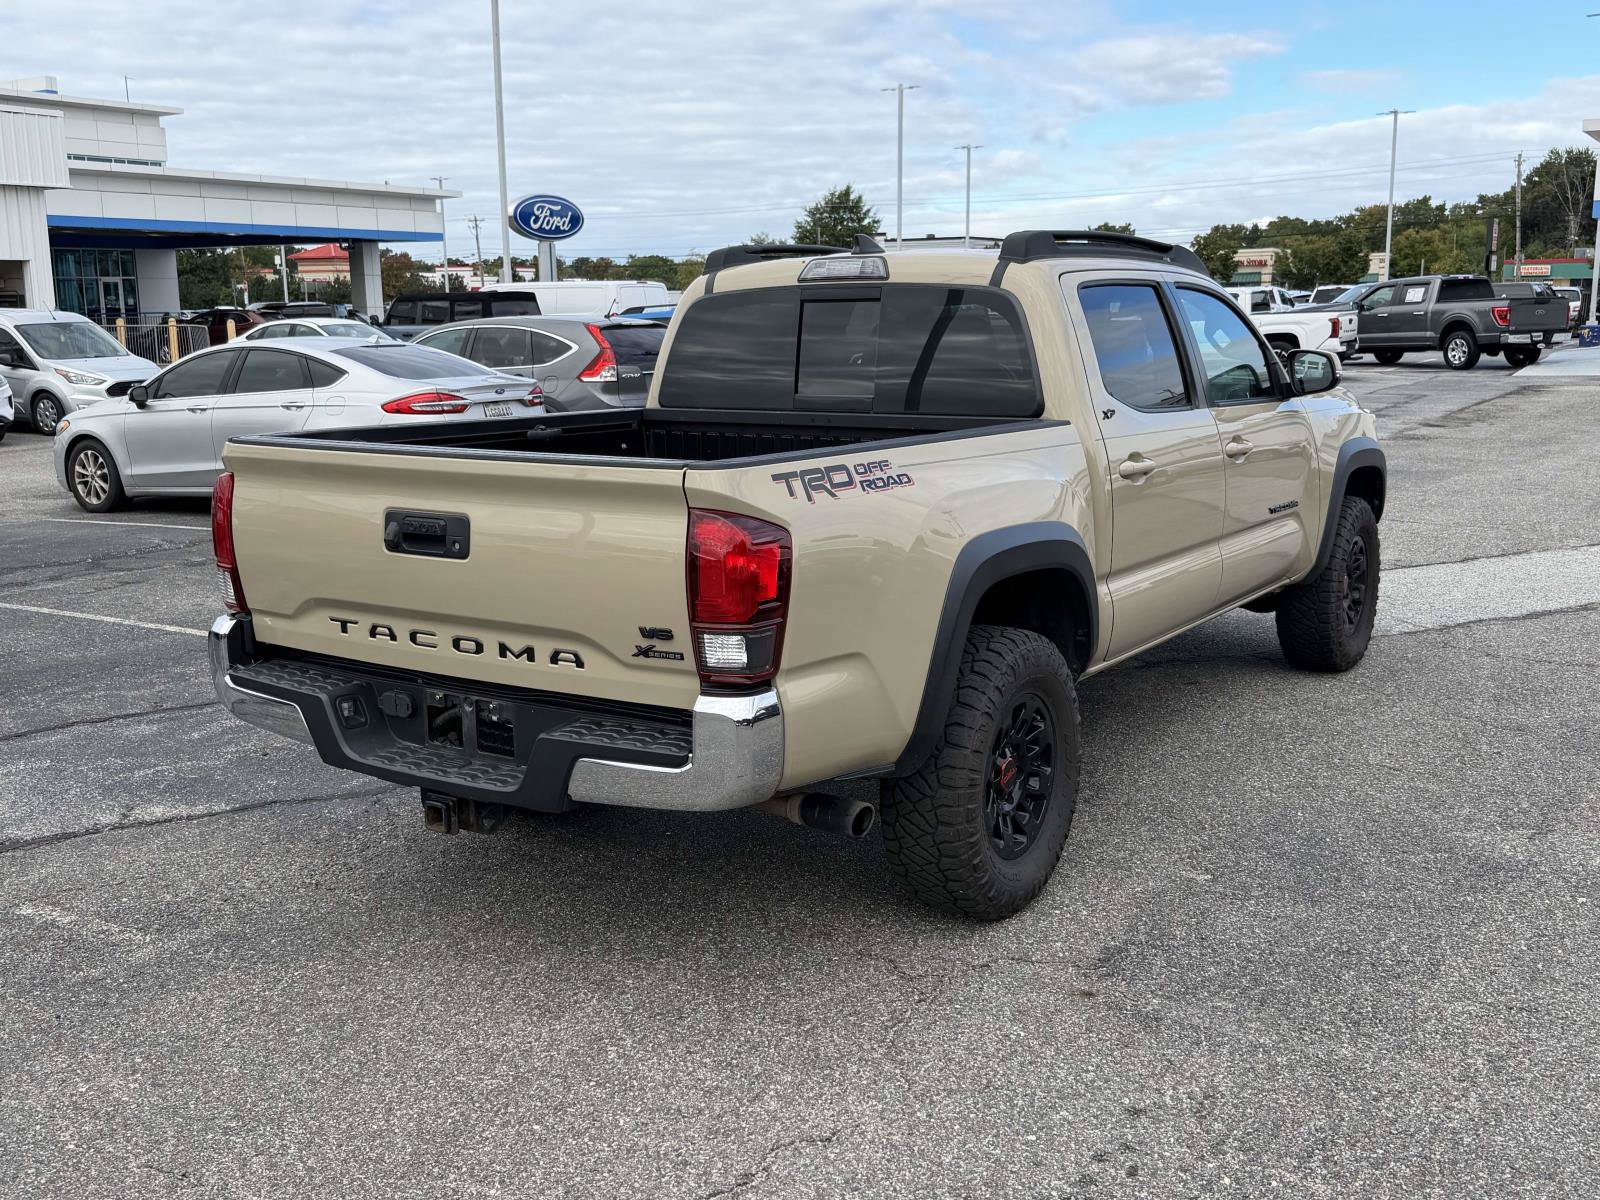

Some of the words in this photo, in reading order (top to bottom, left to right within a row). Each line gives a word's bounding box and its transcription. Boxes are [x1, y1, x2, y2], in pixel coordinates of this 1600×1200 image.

[530, 203, 572, 230] Ford
[853, 459, 893, 478] OFF
[770, 463, 857, 504] TRD
[858, 473, 915, 494] ROAD
[328, 616, 586, 670] TACOMA
[638, 626, 674, 640] V6
